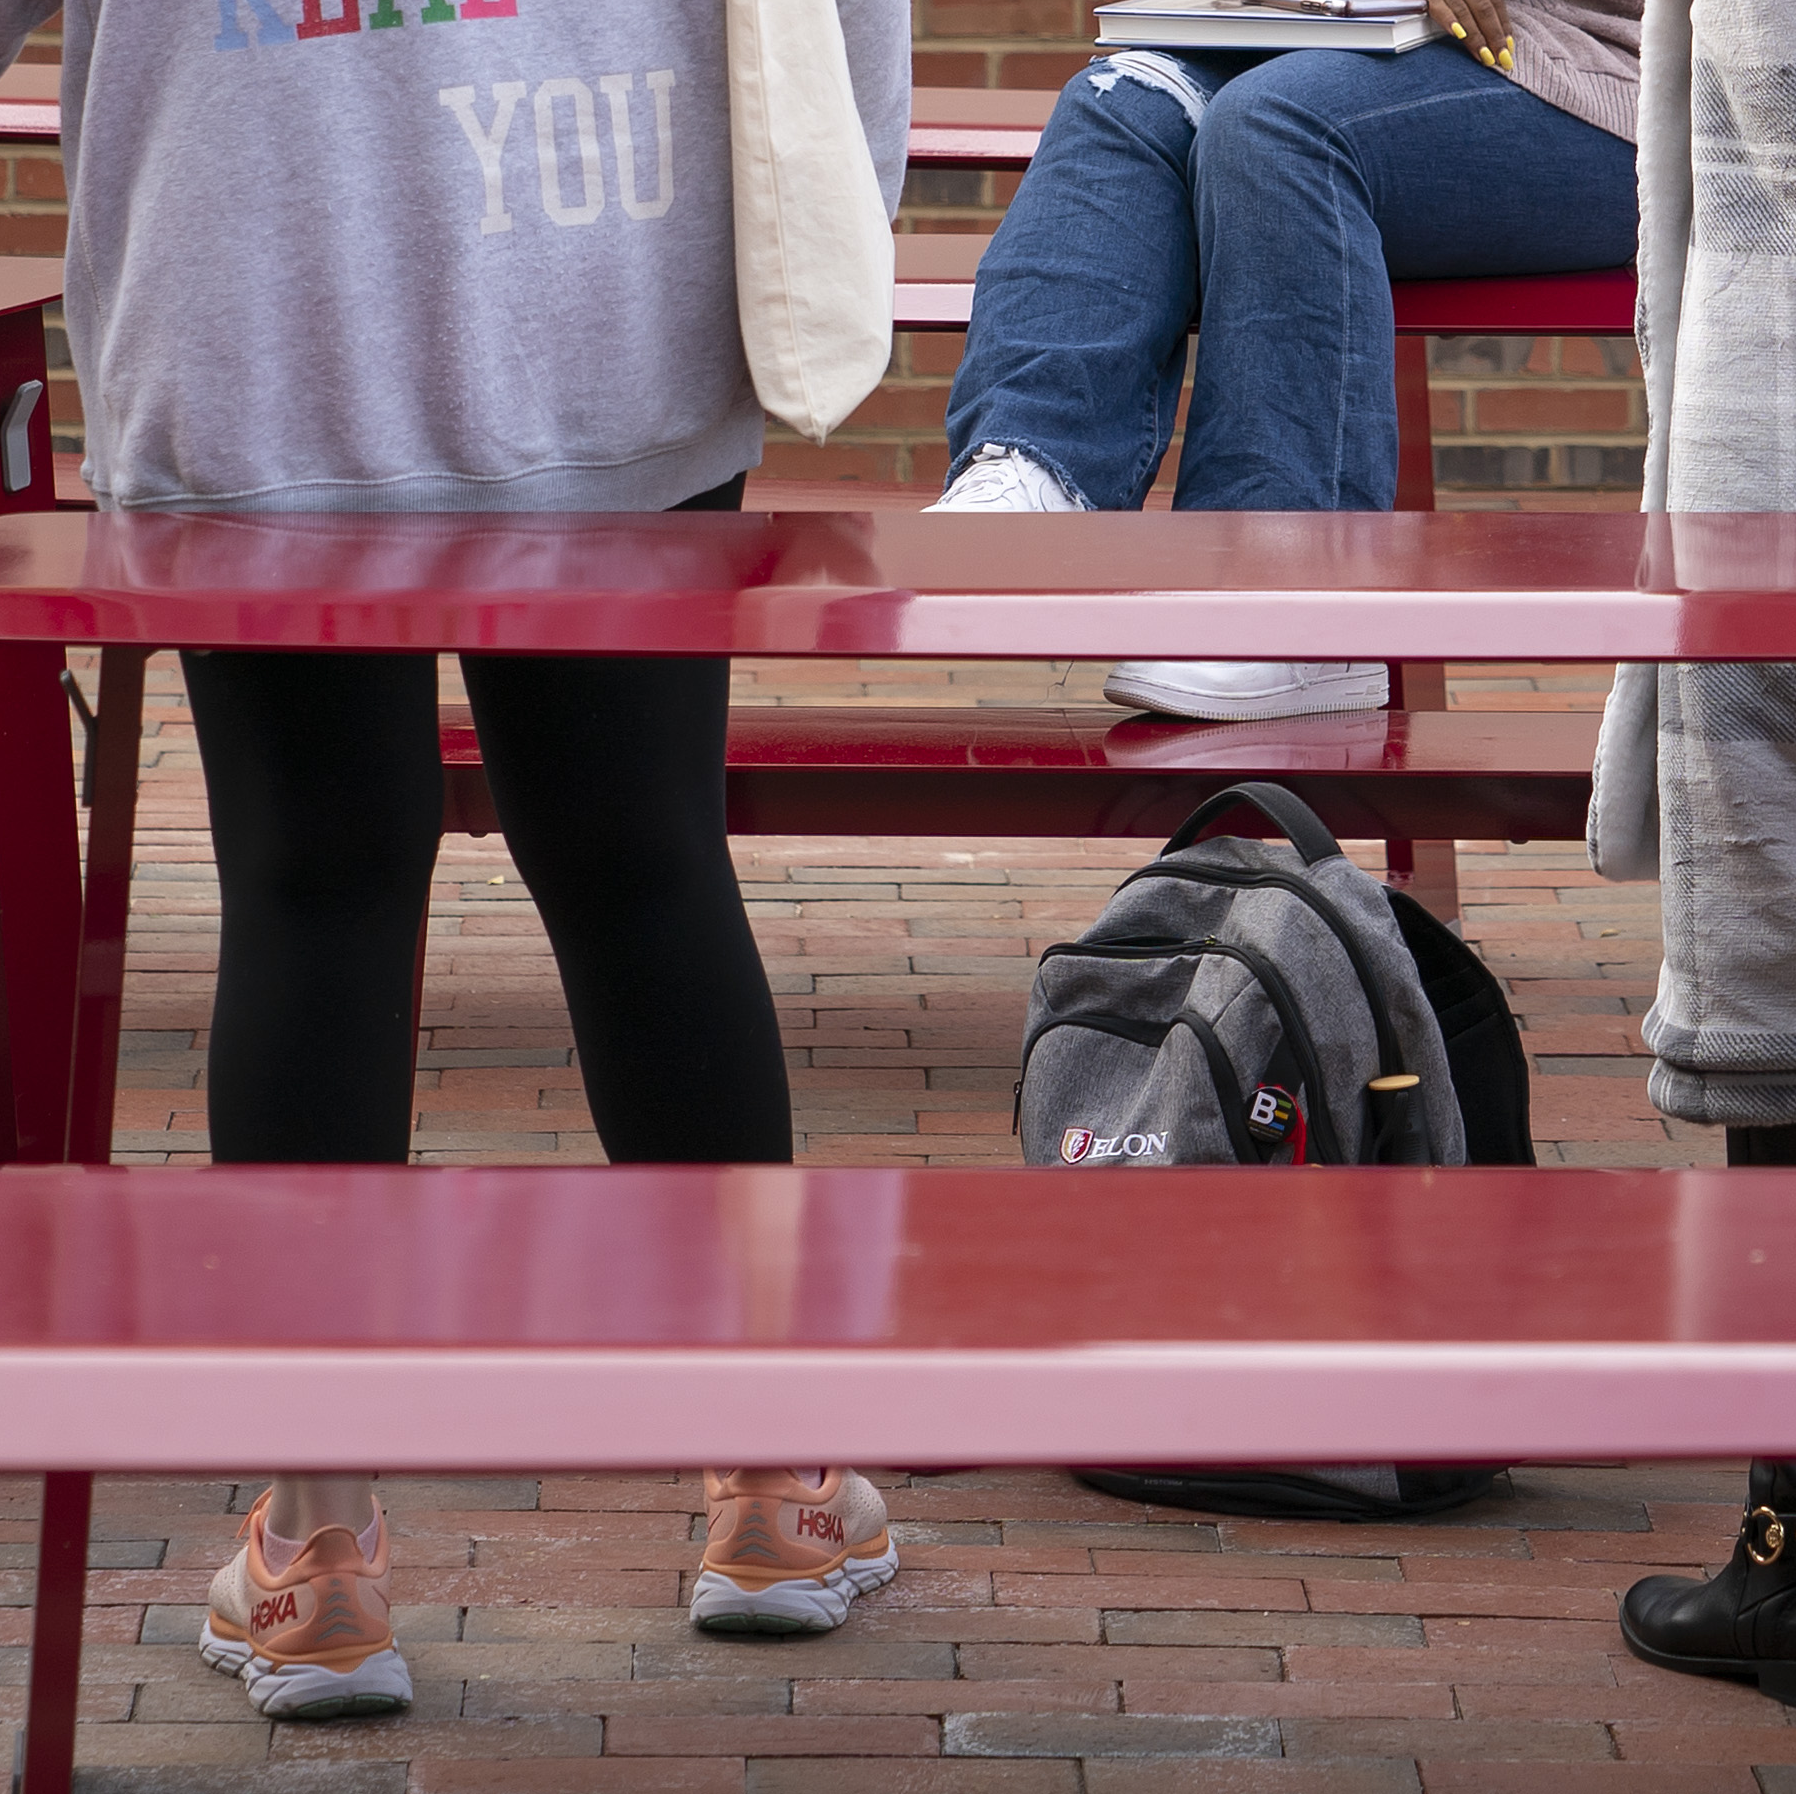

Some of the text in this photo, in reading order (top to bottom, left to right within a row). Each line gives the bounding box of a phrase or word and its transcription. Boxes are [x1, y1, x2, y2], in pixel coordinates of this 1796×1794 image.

[438, 69, 675, 236] YOU
[1087, 1131, 1169, 1159] ELON
[796, 1508, 845, 1546] HOKA
[250, 1591, 298, 1637] HOKA
